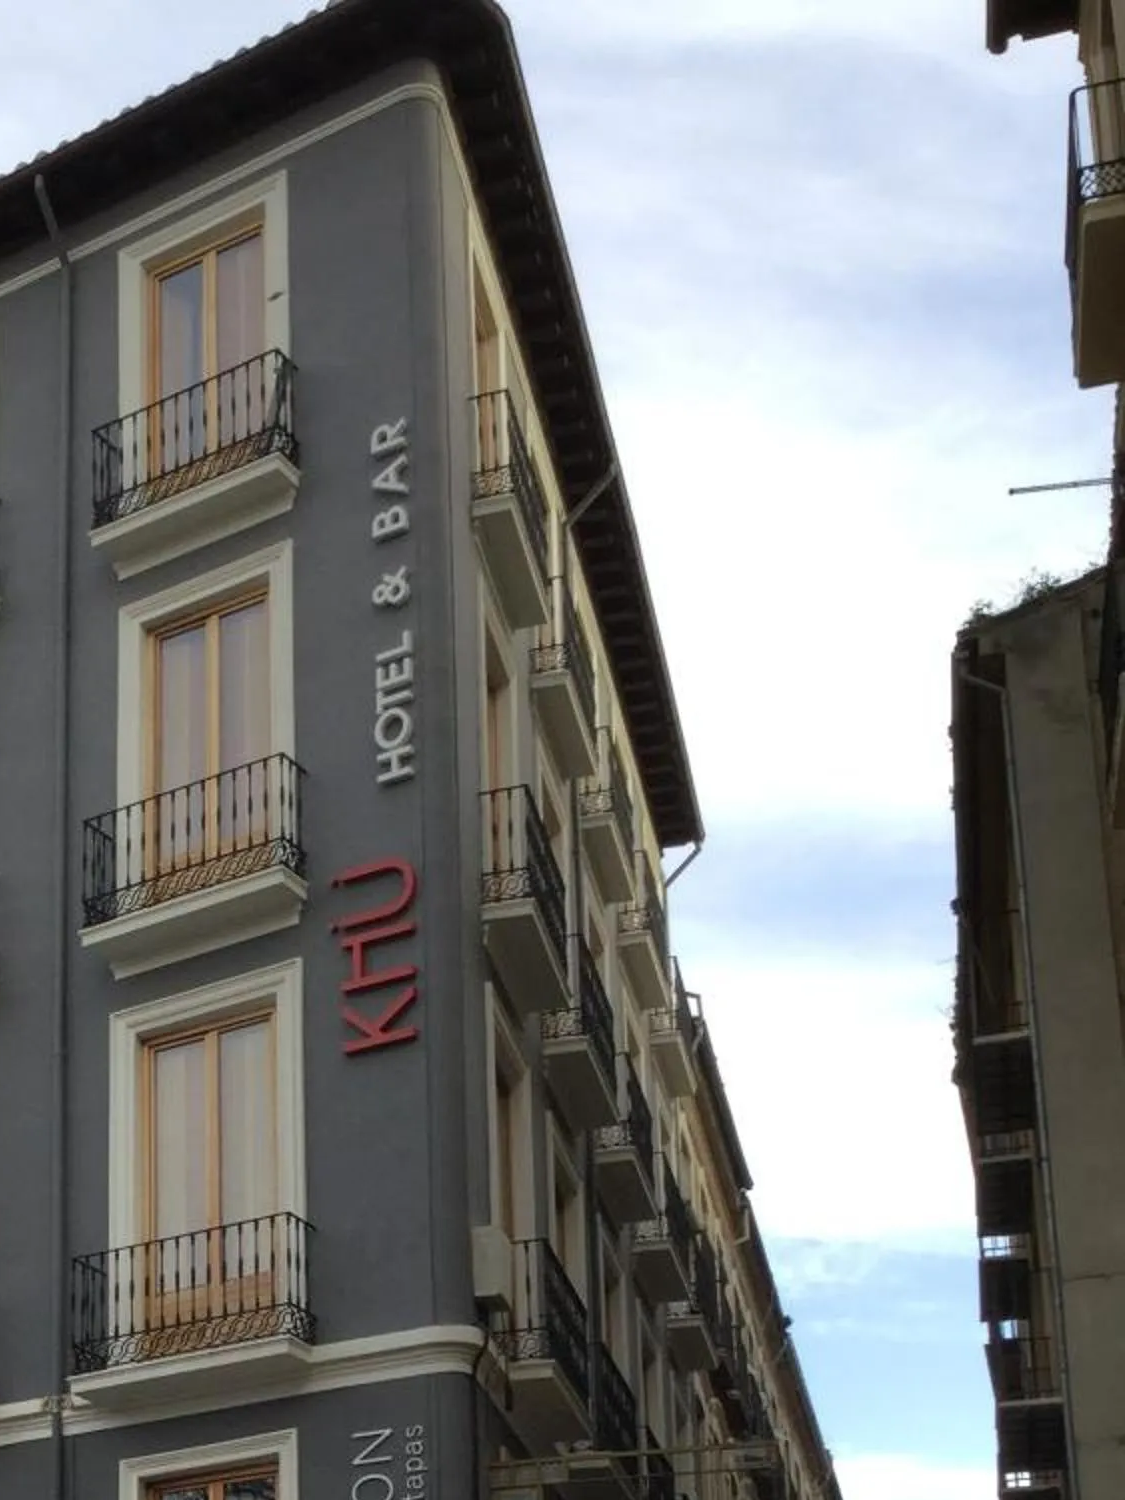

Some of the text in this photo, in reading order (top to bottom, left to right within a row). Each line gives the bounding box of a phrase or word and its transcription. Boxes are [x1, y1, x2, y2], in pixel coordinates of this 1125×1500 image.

[370, 415, 416, 785] HOTEL & BAR
